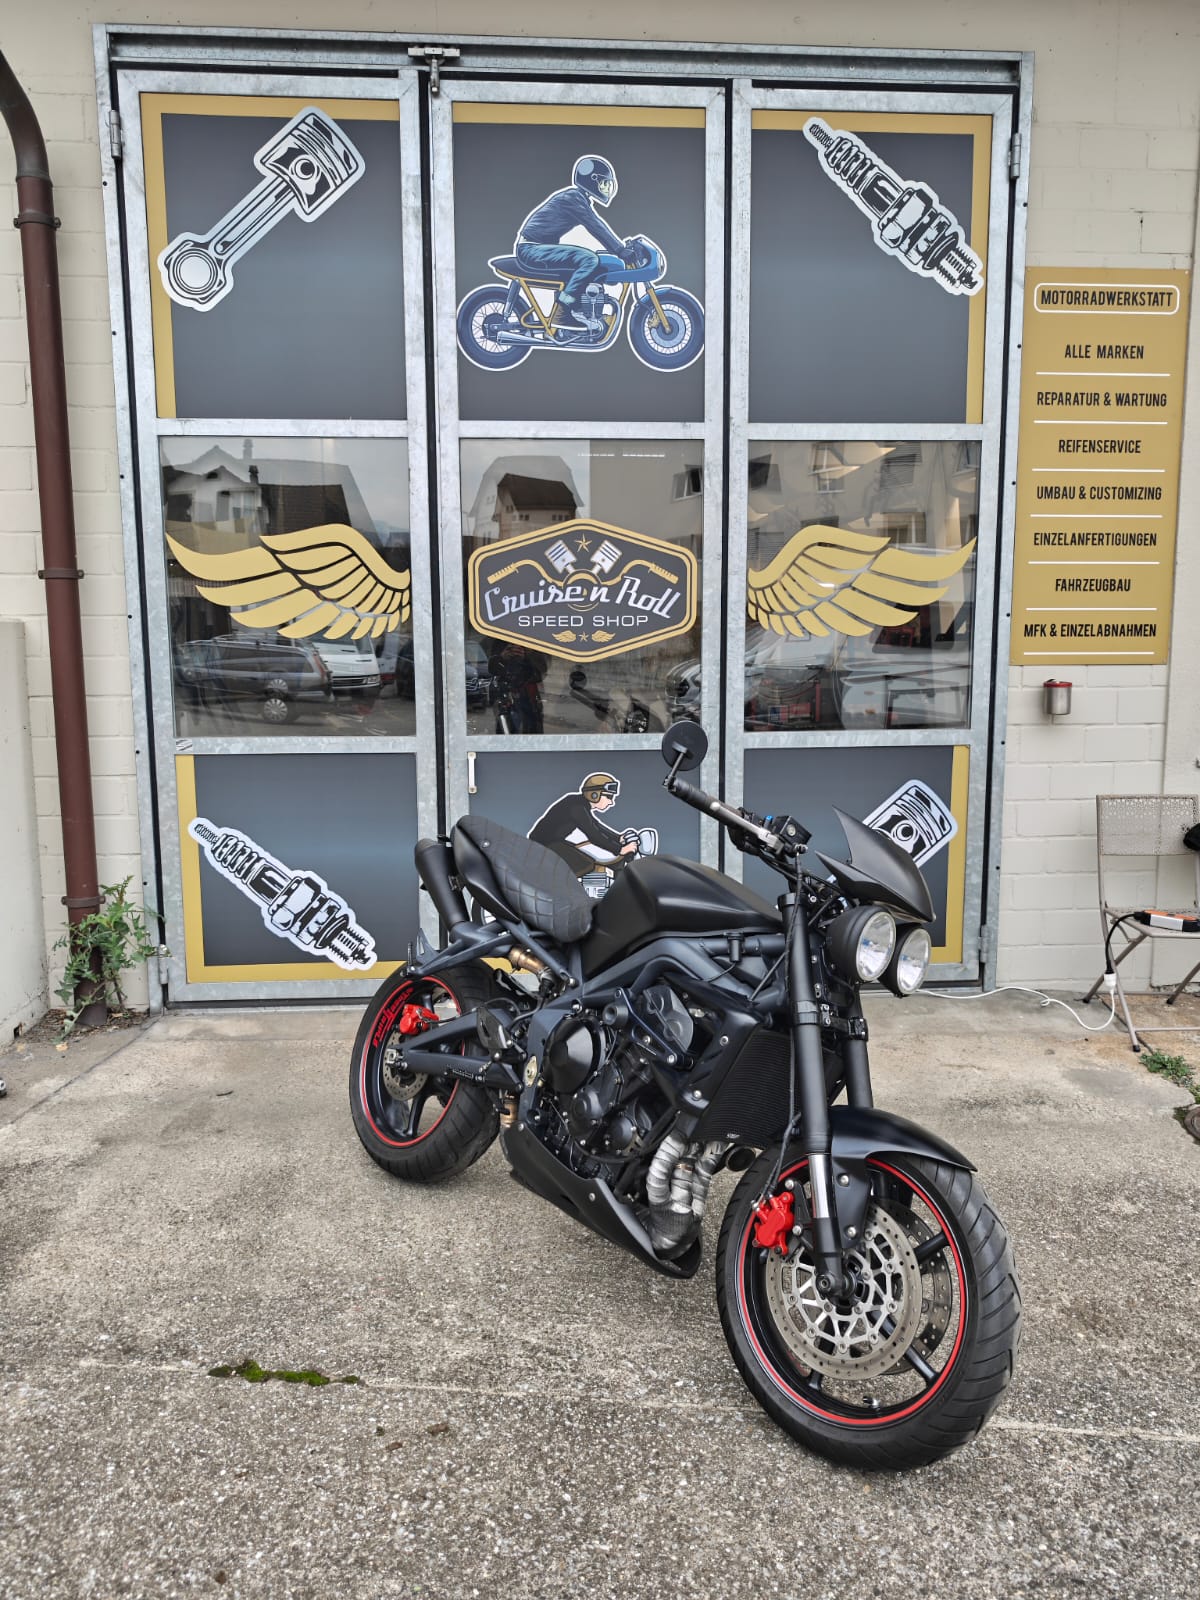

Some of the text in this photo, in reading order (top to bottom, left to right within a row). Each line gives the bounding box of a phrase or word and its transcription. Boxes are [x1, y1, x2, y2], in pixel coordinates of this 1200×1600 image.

[1041, 290, 1173, 307] MOTORRADWERKSTATT
[1064, 344, 1144, 359] ALLE MARKEN
[1037, 391, 1167, 407] REPARATUR & WARTUNG
[1058, 439, 1141, 453] REIFENSERVICE
[1036, 486, 1162, 500] UMBAU & CUSTOMIZING
[1033, 532, 1157, 546] EINZELANFERTIGUNGEN
[1055, 578, 1131, 592] FAHRZEUGBAU
[484, 575, 681, 622] Cruise n Roll
[518, 615, 649, 627] SPEED SHOP
[1024, 623, 1157, 637] MFK & EINZELABNAHMEN
